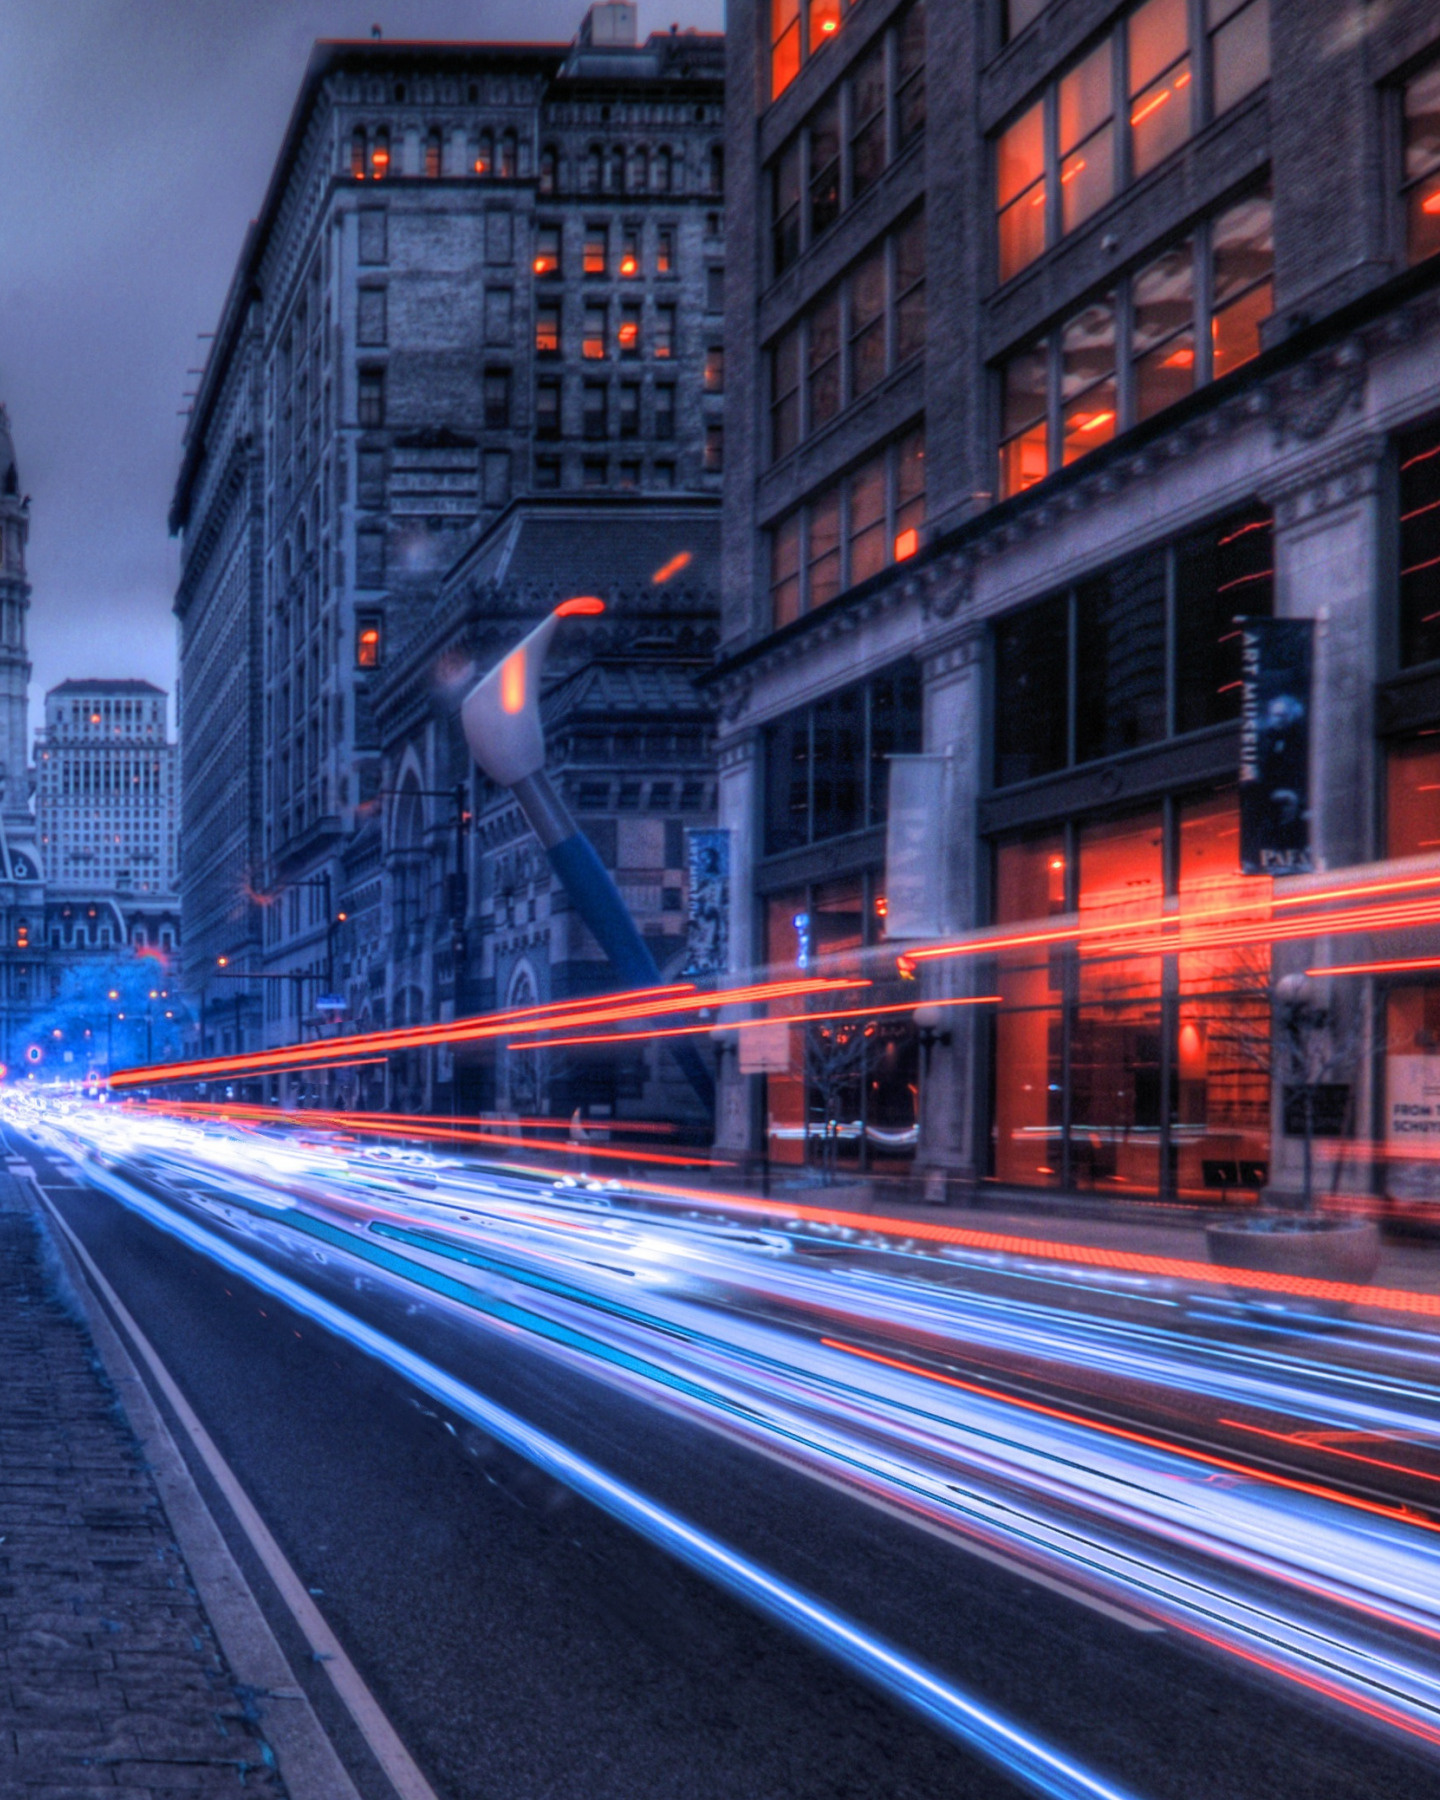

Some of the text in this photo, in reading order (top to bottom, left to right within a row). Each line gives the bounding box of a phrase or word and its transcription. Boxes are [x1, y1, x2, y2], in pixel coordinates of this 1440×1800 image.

[1240, 631, 1259, 782] ART MUSEUM
[1394, 1104, 1430, 1115] FROM
[1394, 1121, 1440, 1132] SCHUY
